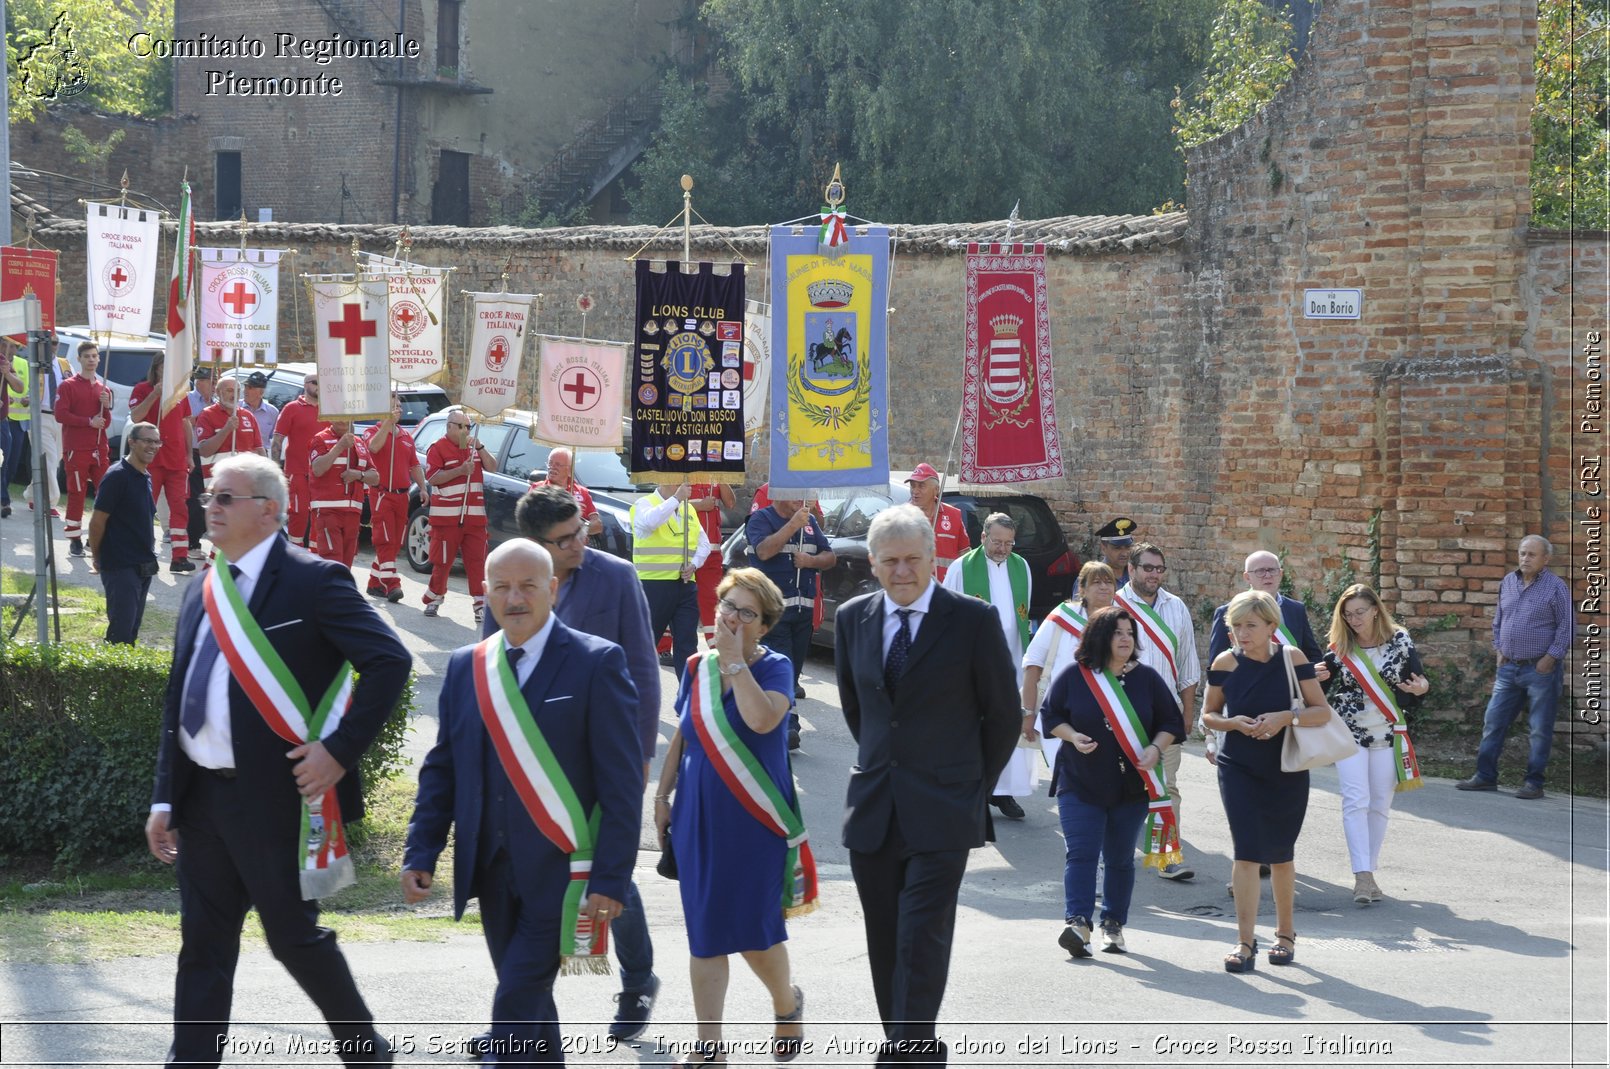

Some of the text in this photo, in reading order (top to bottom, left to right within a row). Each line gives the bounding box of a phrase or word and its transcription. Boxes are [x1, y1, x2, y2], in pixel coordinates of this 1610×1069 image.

[101, 232, 142, 243] CROCE ROSSA
[108, 241, 134, 250] ITALIANA
[811, 260, 819, 269] DI
[208, 267, 273, 295] CROCE ROSSA ITALIANA
[410, 277, 437, 285] ROSSA
[389, 286, 426, 294] TALIANA
[1328, 291, 1336, 299] via
[118, 305, 142, 314] LOCALE
[652, 304, 725, 319] LIONS CLUB
[1311, 300, 1354, 314] Don Borio
[505, 311, 524, 321] ROSSA
[206, 322, 271, 331] COMITATO LOCALE
[486, 320, 517, 330] ITALIANA
[206, 340, 248, 348] COCCONATO
[672, 334, 703, 348] LIONS
[749, 322, 770, 360] ITALIANA
[389, 349, 433, 357] ONTIGLIO
[389, 357, 438, 365] NFERRATO
[682, 351, 695, 373] L
[550, 356, 611, 388] CROCE ROSSA ITALIANA
[551, 414, 607, 426] DELEGAZIONE DI
[691, 411, 706, 422] DON
[709, 409, 736, 422] BOSCO
[557, 423, 600, 436] MONCALVO
[649, 422, 723, 435] ALTO ASTIGIANO
